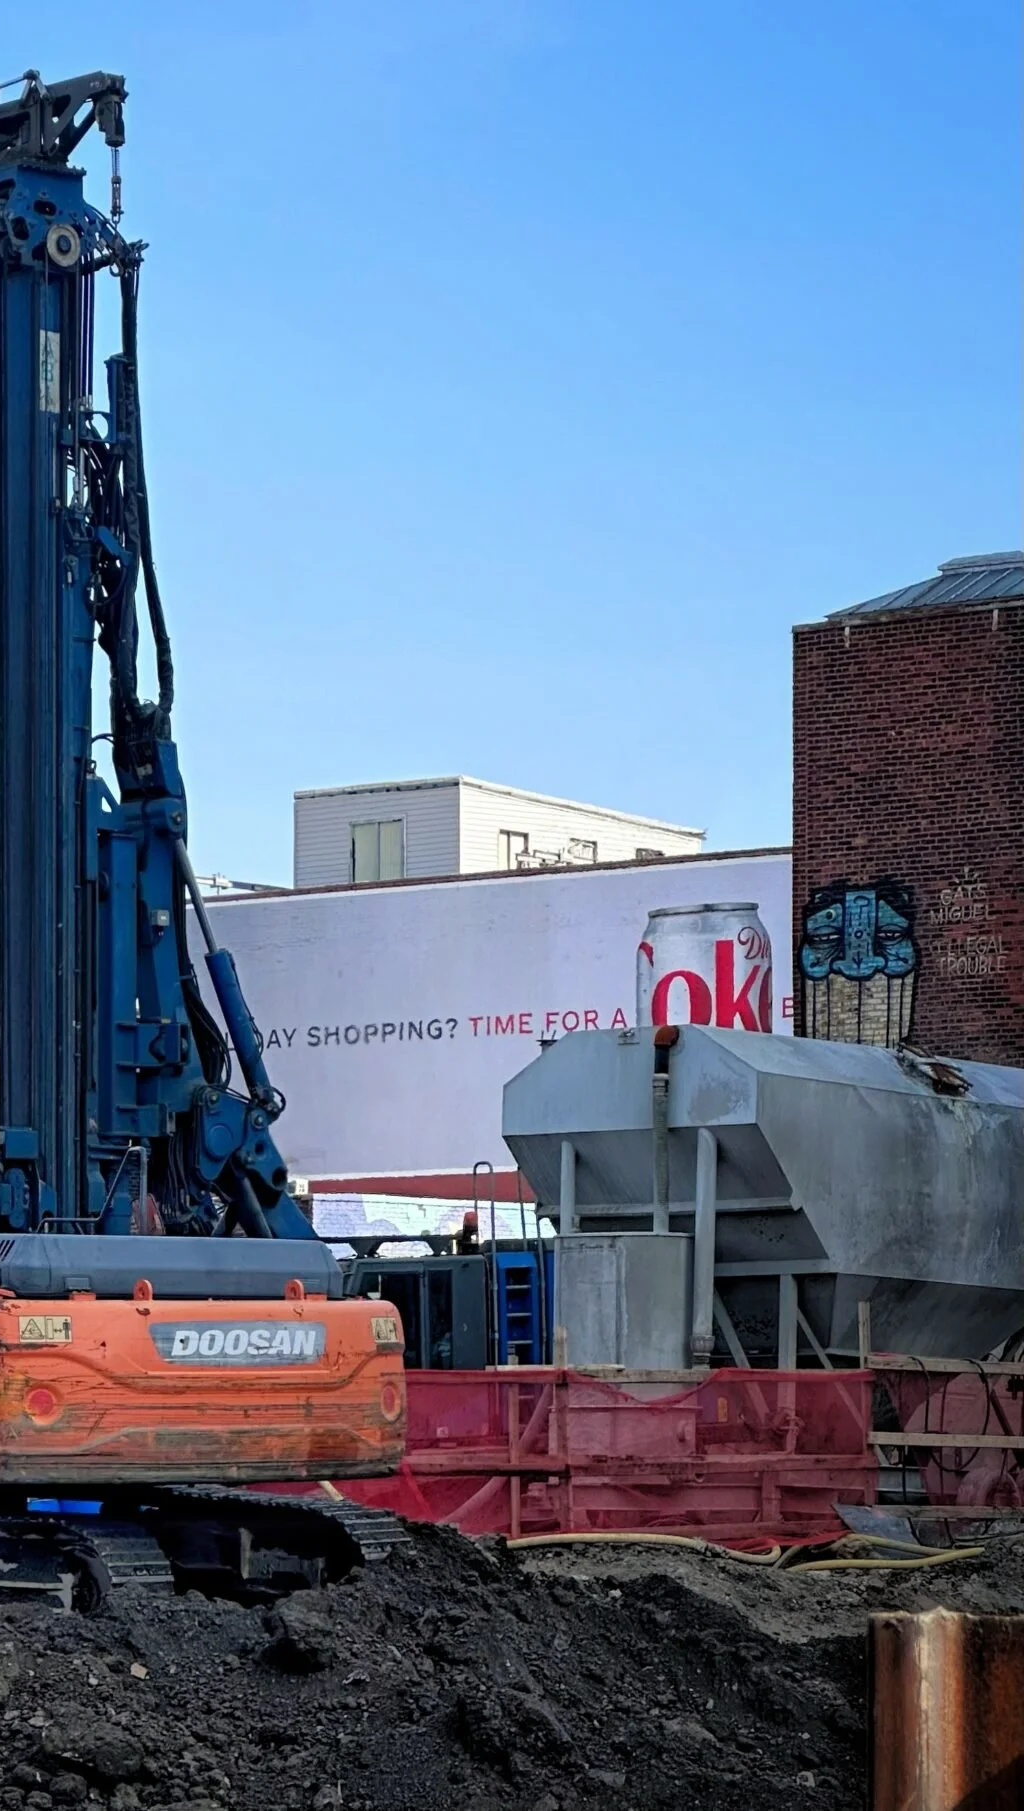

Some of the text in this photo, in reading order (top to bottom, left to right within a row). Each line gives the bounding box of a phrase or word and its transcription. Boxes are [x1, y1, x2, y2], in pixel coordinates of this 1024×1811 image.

[930, 903, 996, 925] MIGUEL
[307, 1018, 458, 1047] SHOPPING?
[468, 1012, 533, 1037] TIME
[546, 1009, 599, 1032] FOR
[611, 1007, 628, 1029] A
[171, 1329, 317, 1356] DOOSAN
